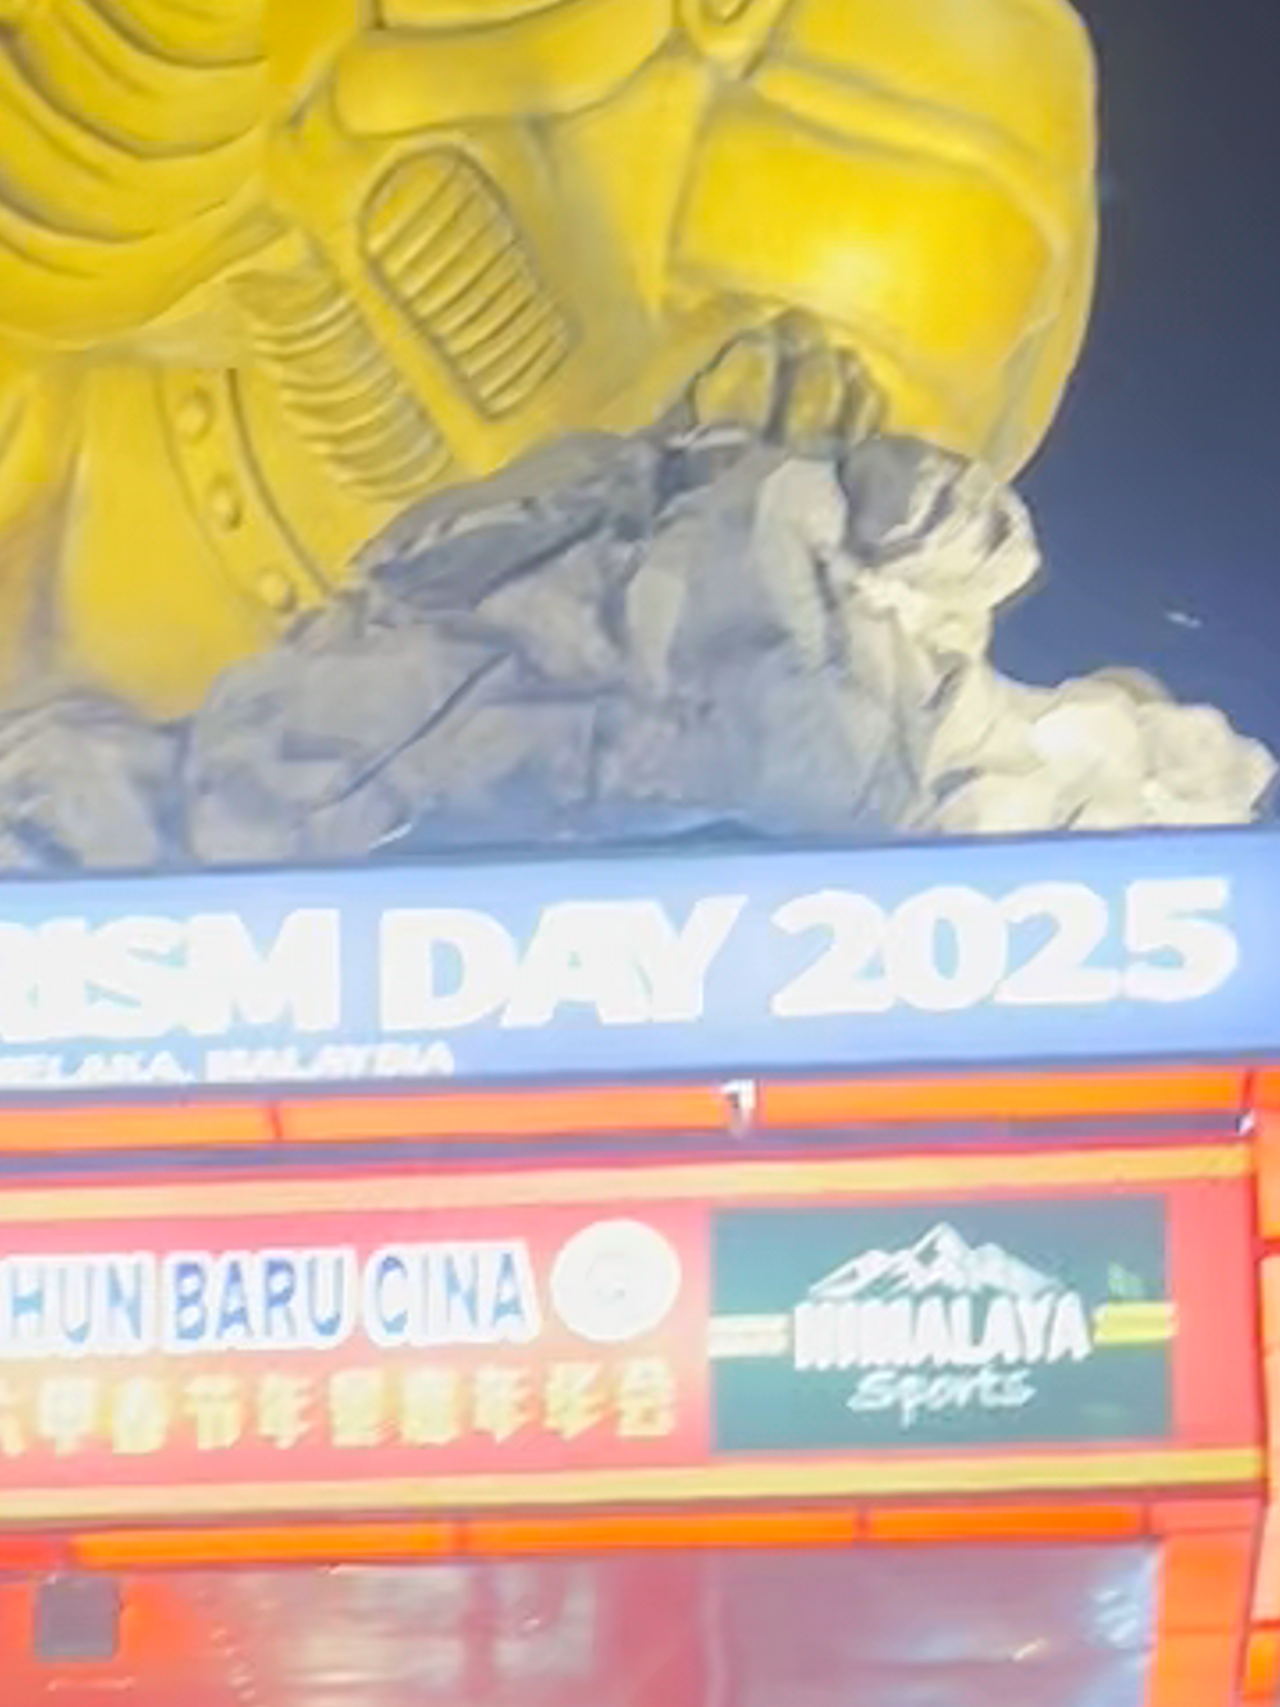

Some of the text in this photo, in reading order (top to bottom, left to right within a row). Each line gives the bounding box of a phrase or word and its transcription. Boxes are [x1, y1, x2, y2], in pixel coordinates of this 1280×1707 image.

[378, 891, 749, 1033] DAY
[770, 876, 1240, 1017] 2025
[172, 1250, 350, 1345] BARU
[365, 1243, 527, 1337] CINA
[792, 1291, 1092, 1371] HIMALAYA
